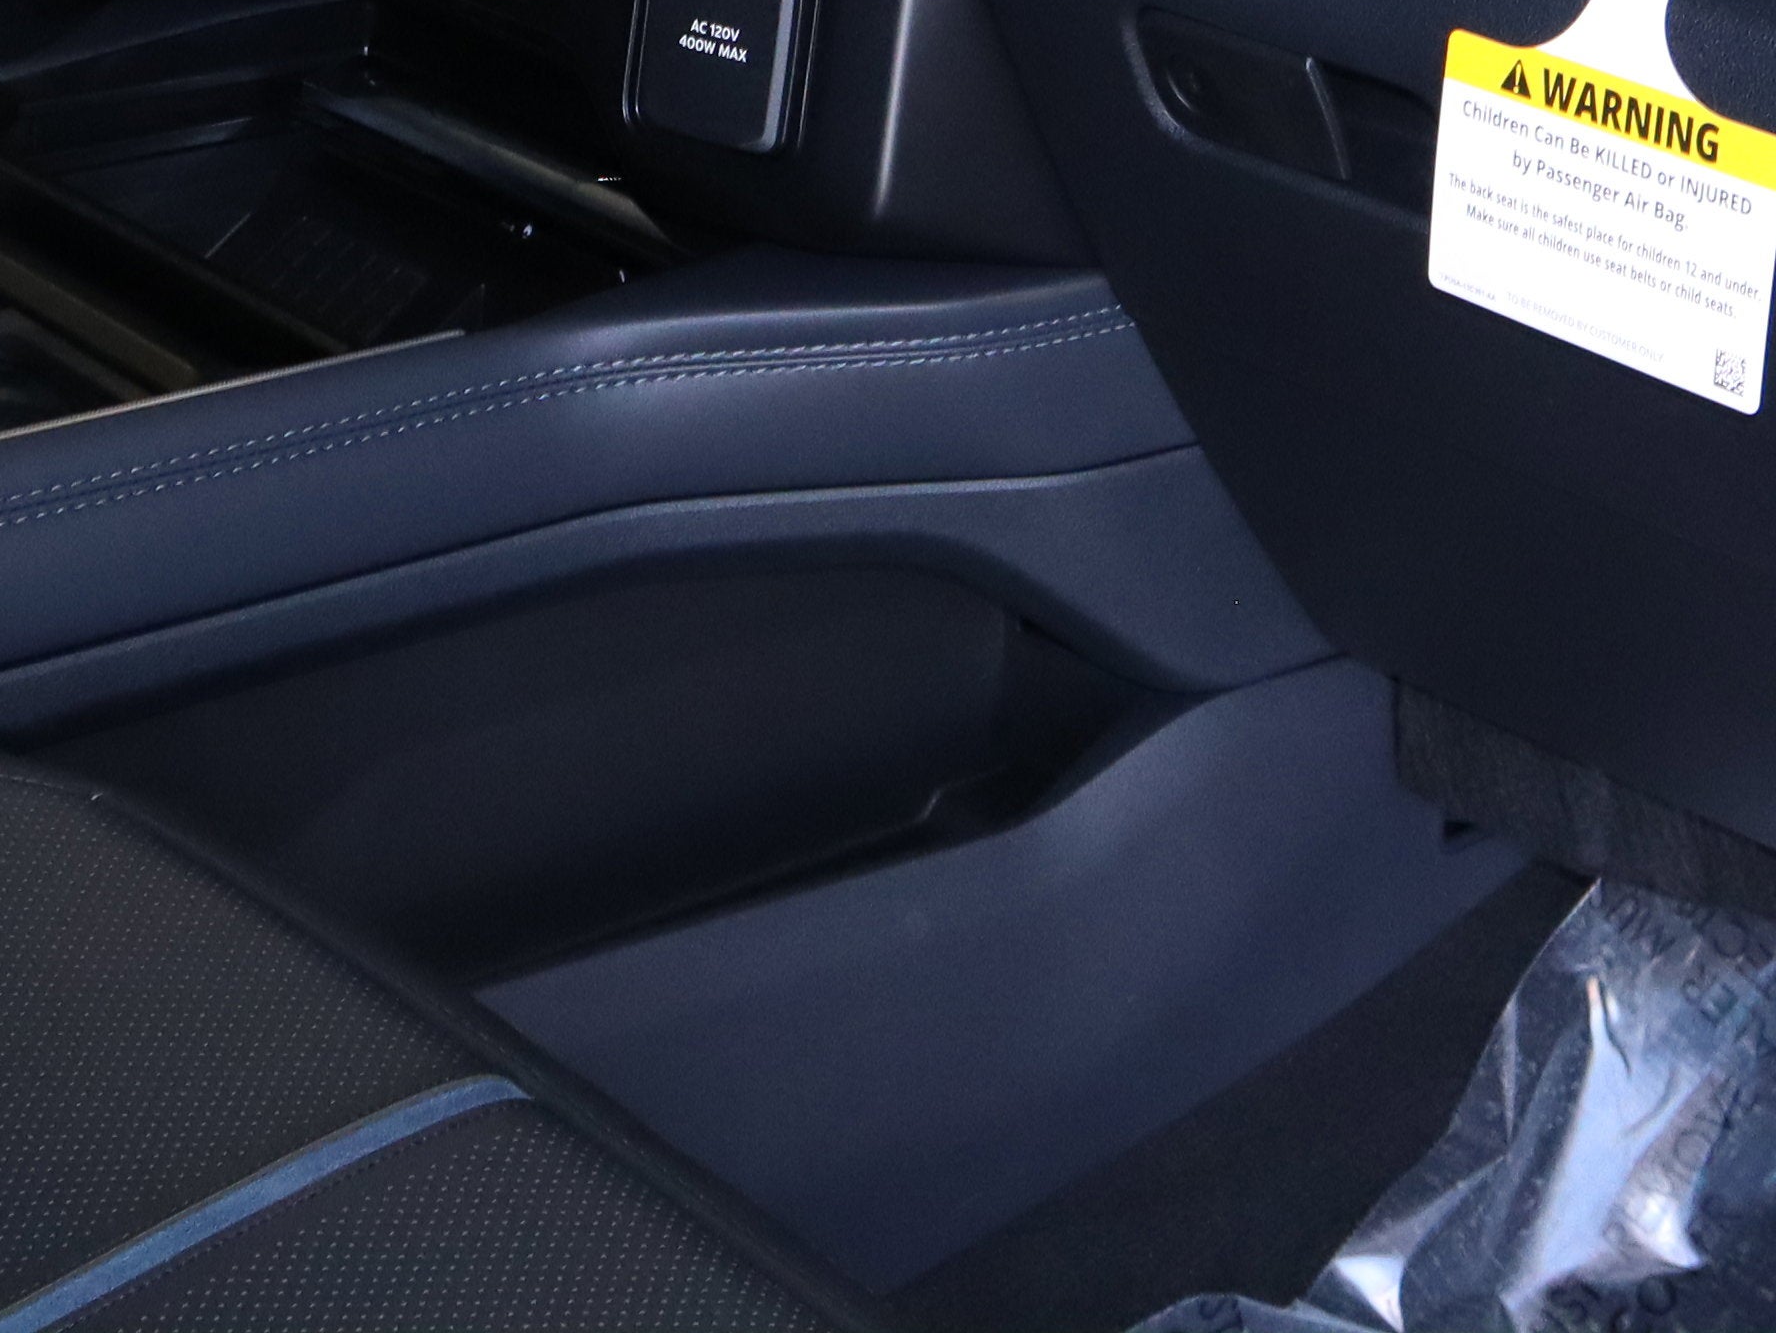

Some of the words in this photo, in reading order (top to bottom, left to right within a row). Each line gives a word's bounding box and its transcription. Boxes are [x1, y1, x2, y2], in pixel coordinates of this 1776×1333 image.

[678, 34, 717, 55] 400W
[717, 43, 749, 64] MAX
[690, 17, 708, 35] AC
[709, 22, 740, 42] 120V
[1543, 67, 1720, 164] WARNING
[1462, 99, 1529, 137] Children
[1534, 124, 1565, 150] Can
[1569, 136, 1591, 159] Be
[1594, 145, 1653, 180] KILLED
[1656, 170, 1676, 187] or
[1680, 175, 1753, 216] INJURED
[1511, 149, 1532, 176] by
[1536, 158, 1620, 203] Passenger
[1623, 190, 1650, 214] Air
[1449, 171, 1467, 191] The
[1469, 180, 1494, 200] back
[1495, 192, 1518, 210] seat
[1519, 201, 1529, 215] is
[1531, 203, 1550, 222] the
[1552, 213, 1584, 236] safest
[1585, 224, 1615, 246] place
[1617, 233, 1634, 252] for
[1635, 243, 1682, 273] children
[1684, 259, 1698, 278] 12
[1700, 268, 1723, 286] and
[1465, 202, 1496, 227] Make
[1496, 217, 1520, 236] sure
[1521, 225, 1536, 241] all
[1536, 231, 1581, 258] children
[1582, 250, 1602, 268] use
[1604, 258, 1628, 277] seat
[1629, 264, 1658, 290] belts
[1659, 278, 1673, 293] or
[1674, 283, 1702, 307] child
[1506, 290, 1519, 306] TO
[1521, 296, 1532, 310] BE
[1533, 301, 1575, 328] REMOVED
[1577, 318, 1589, 334] BY
[1589, 324, 1637, 353] CUSTOMER
